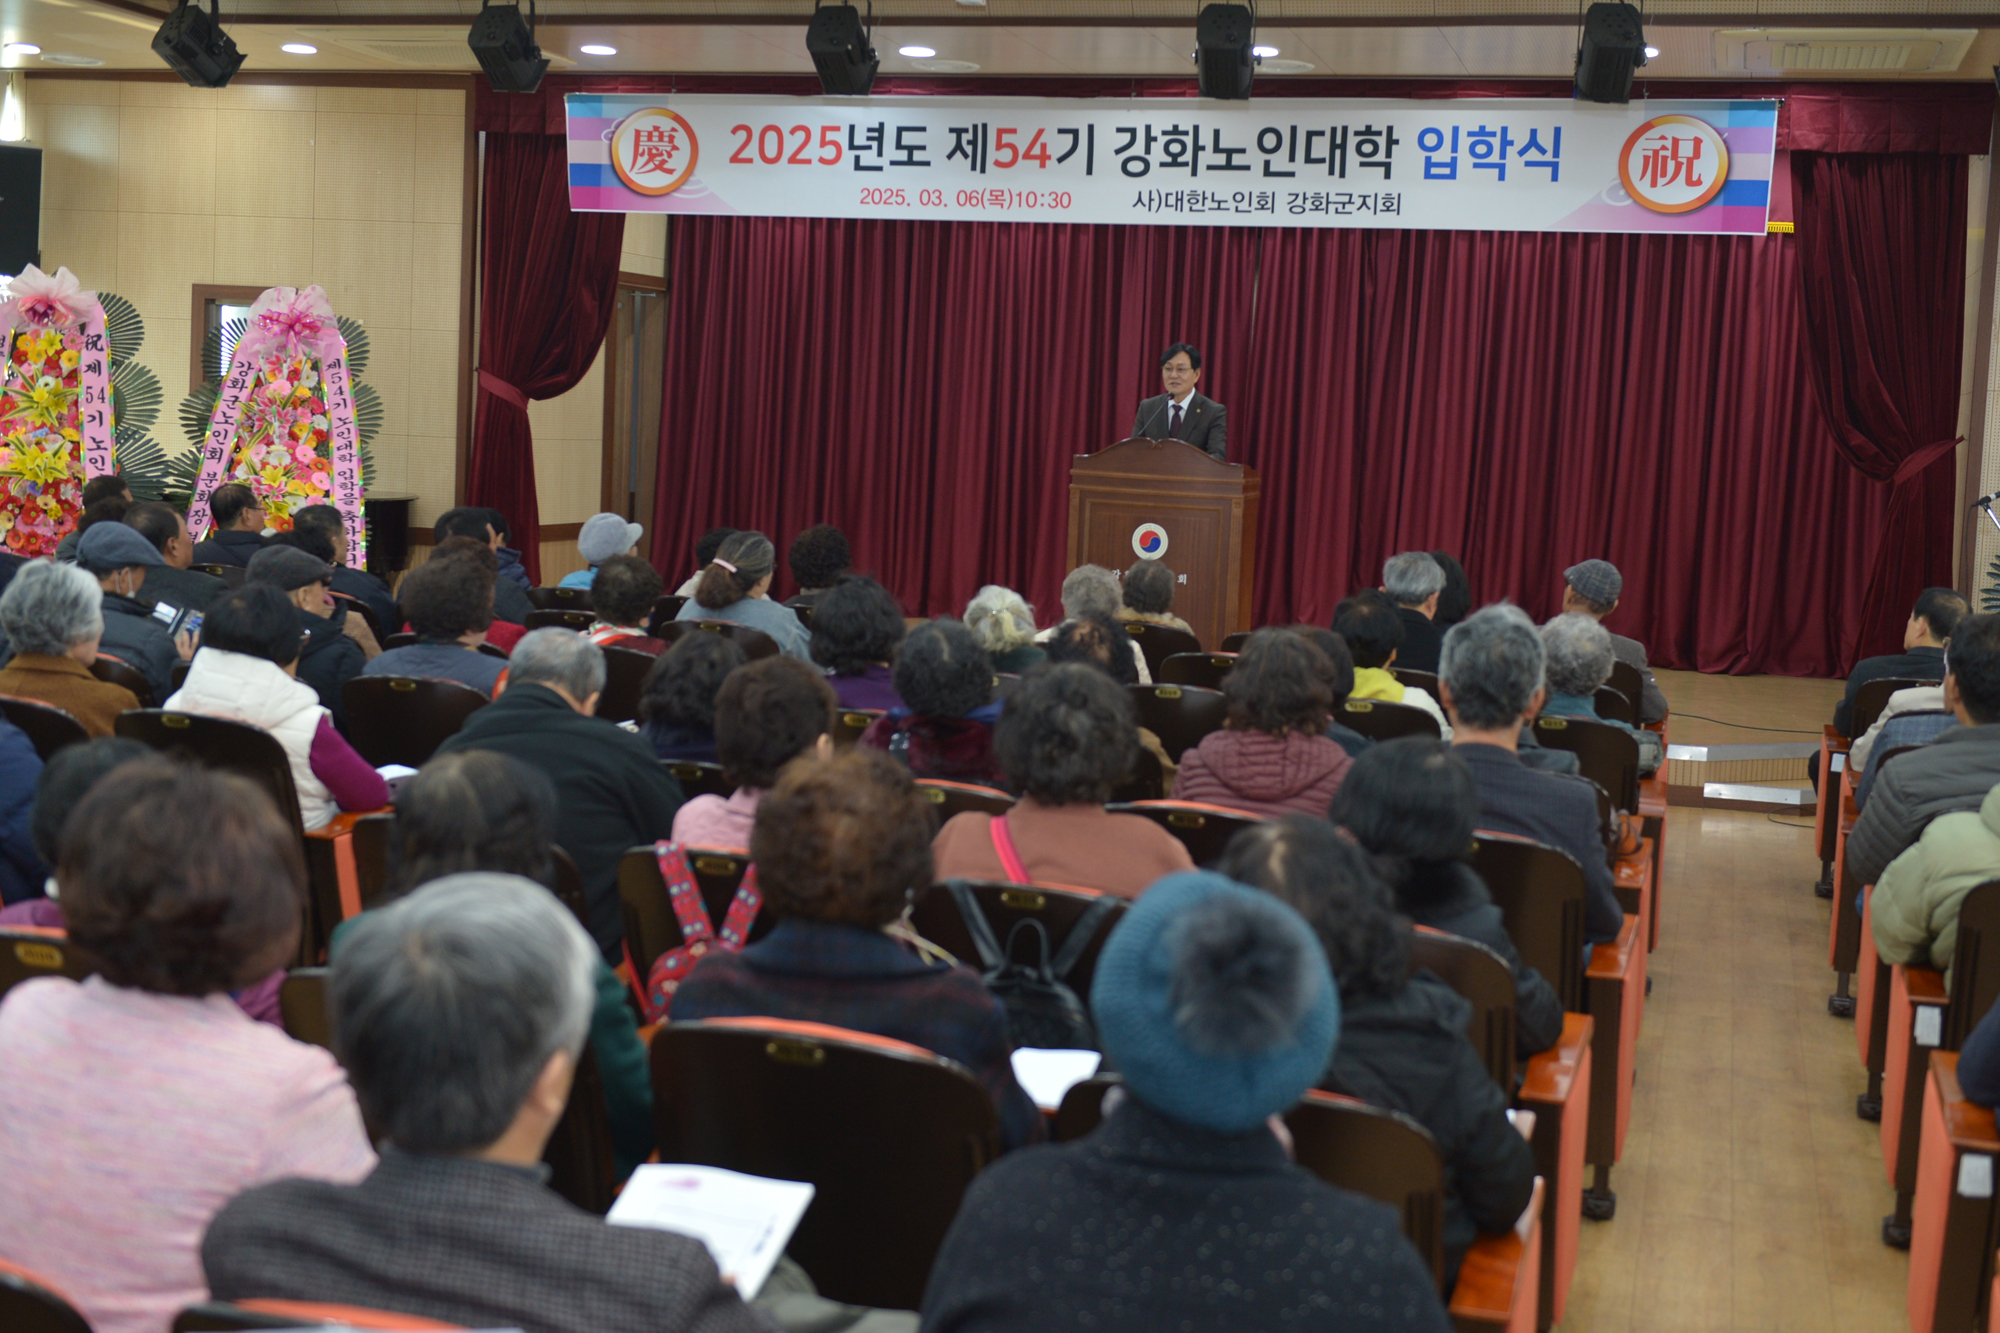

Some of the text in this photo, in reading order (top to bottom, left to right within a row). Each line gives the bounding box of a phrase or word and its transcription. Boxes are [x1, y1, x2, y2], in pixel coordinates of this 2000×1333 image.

[630, 124, 682, 176] 慶
[729, 122, 1562, 182] 2025년도 제54기 강화노인대학 입학식
[1639, 134, 1703, 190] 祝
[859, 187, 1073, 210] 2025. 03. 06(목)10:30
[1132, 189, 1402, 216] 사)대한노인회 강화군지회
[84, 333, 105, 352] 祝
[206, 360, 255, 465] 강화군노인회
